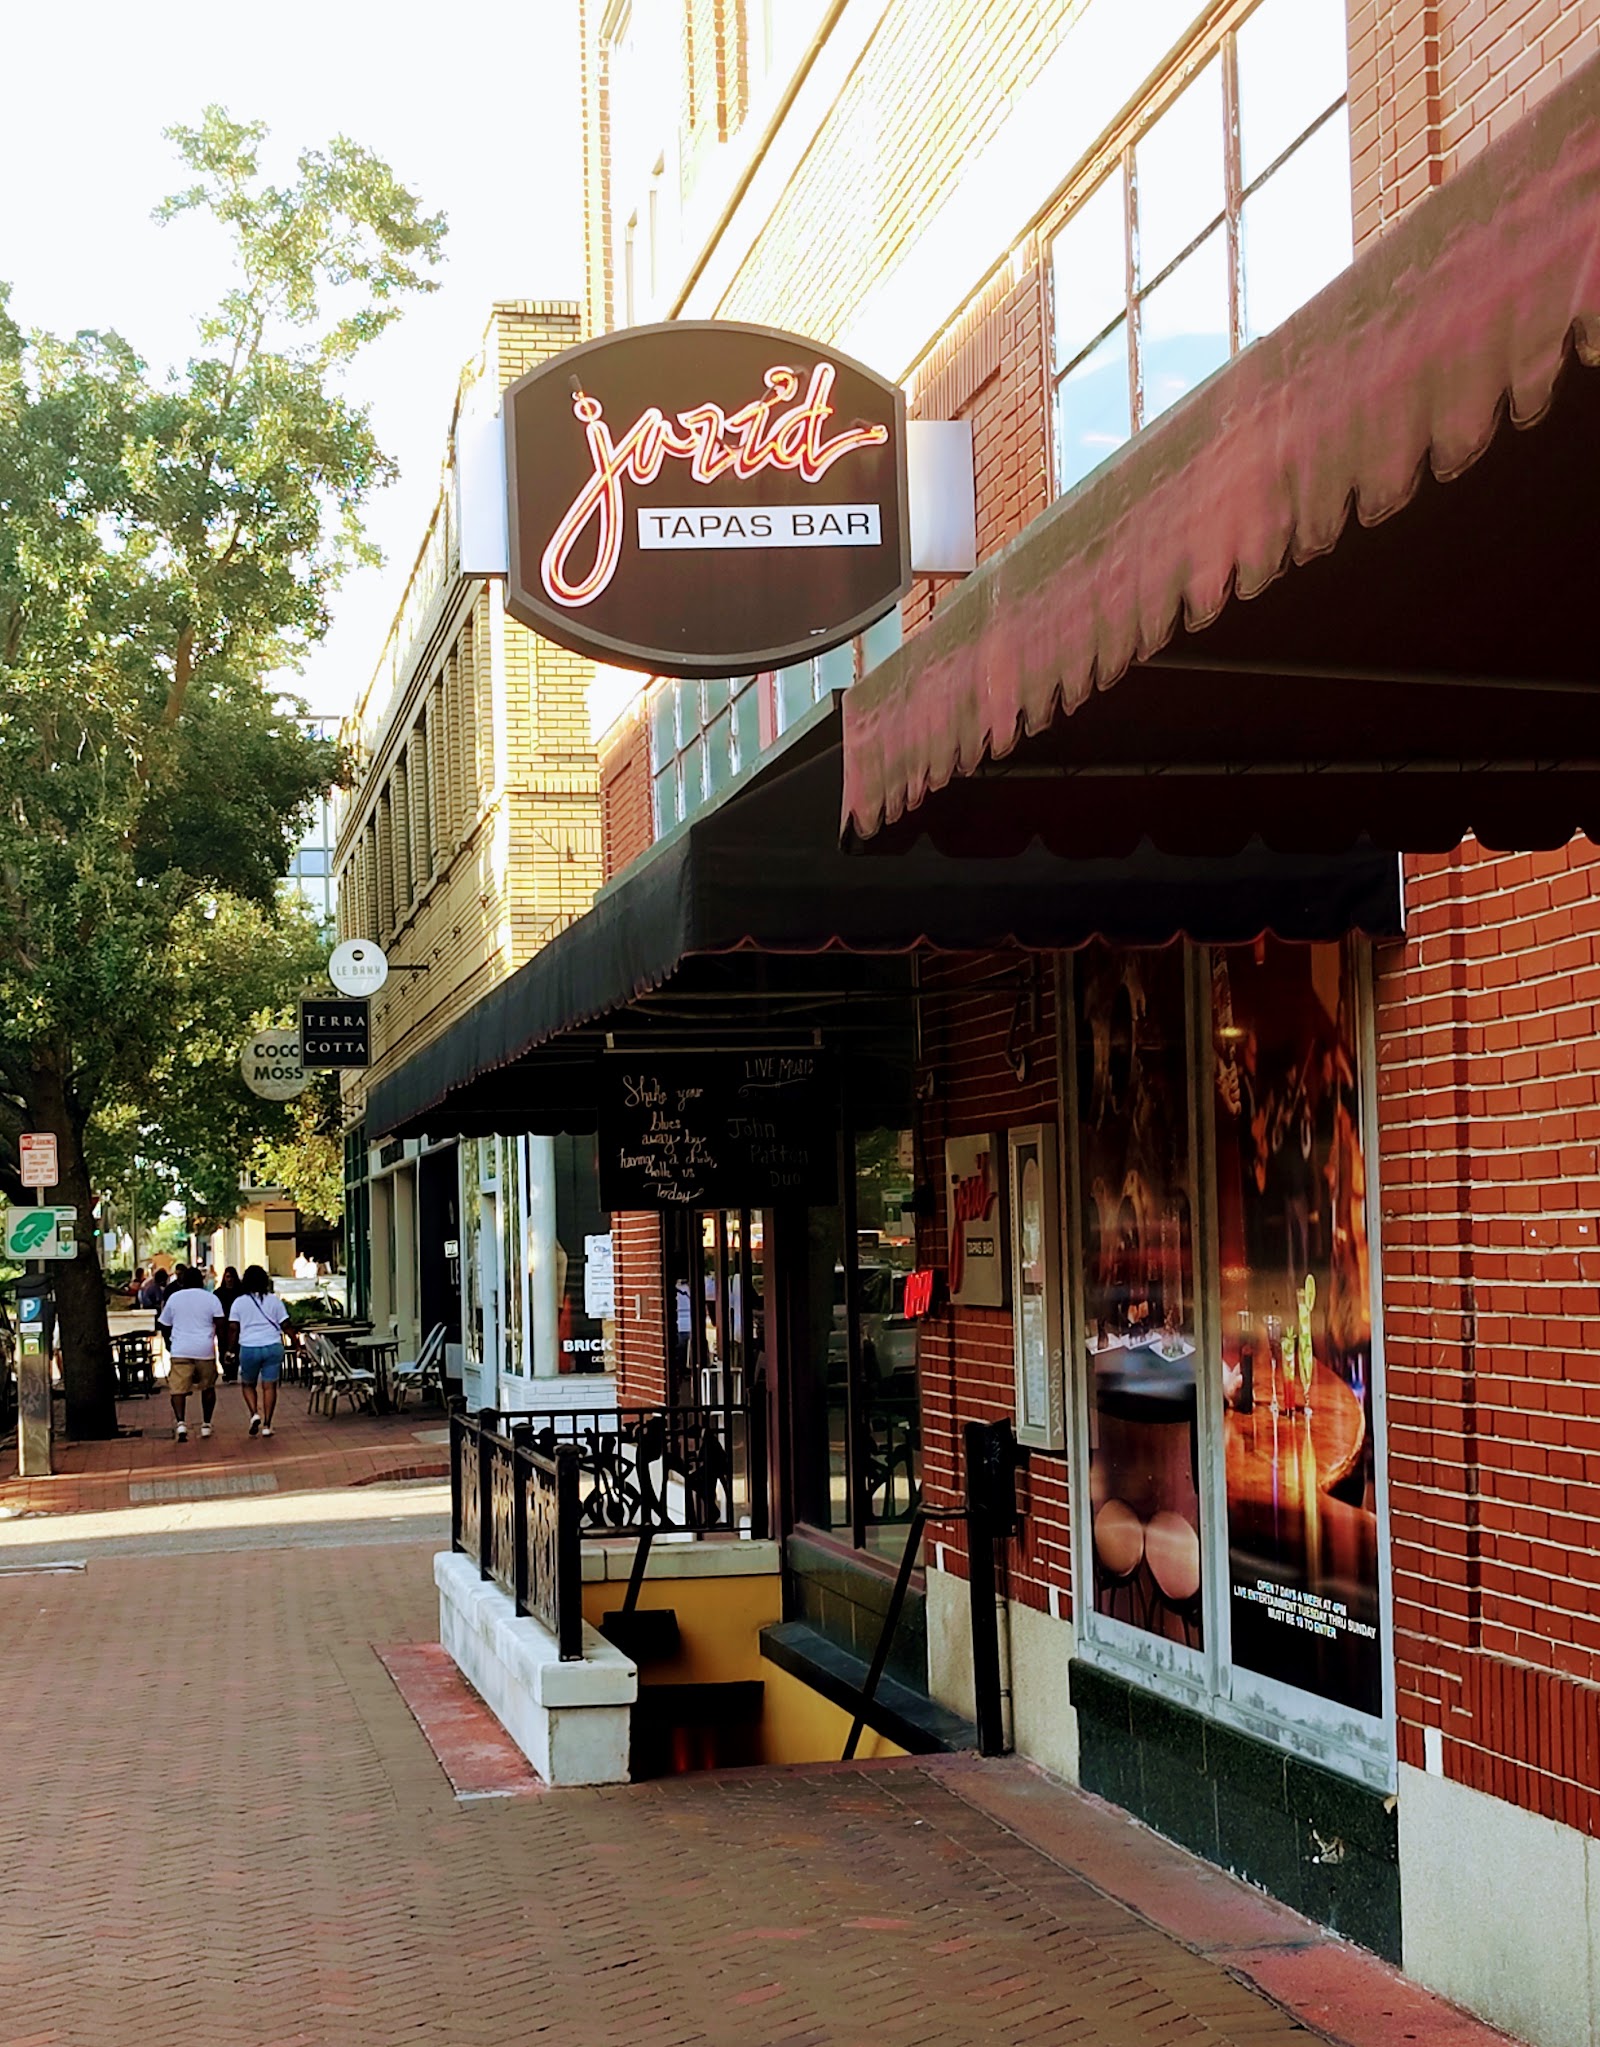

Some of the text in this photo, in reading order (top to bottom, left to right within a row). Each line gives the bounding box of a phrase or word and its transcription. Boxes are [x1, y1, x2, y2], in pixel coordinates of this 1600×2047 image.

[650, 512, 871, 539] TAPAS BAR
[336, 965, 347, 976] LE
[304, 1014, 366, 1027] TERRA
[305, 1040, 365, 1053] COTTA
[254, 1066, 304, 1080] MOSS
[745, 1058, 775, 1079] LIVE
[650, 1111, 681, 1131] blues
[641, 1133, 680, 1155] away
[563, 1339, 613, 1352] BRICK
[1257, 1580, 1274, 1594] OPEN
[1280, 1586, 1297, 1601] DAYS
[1323, 1599, 1332, 1611] AT
[1268, 1607, 1285, 1622] MUST
[1304, 1617, 1313, 1631] TO
[1314, 1621, 1337, 1639] ENTER
[1348, 1619, 1376, 1639] SUNDAY
